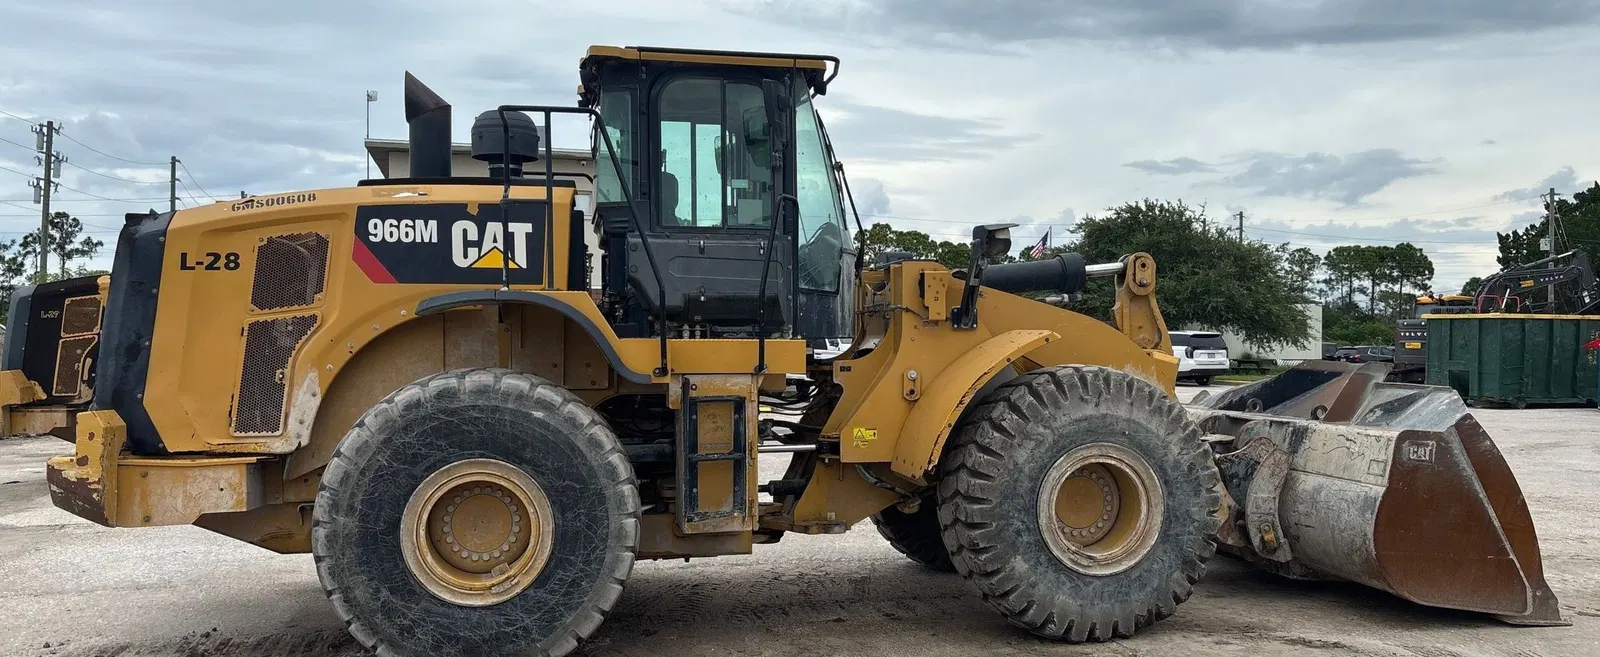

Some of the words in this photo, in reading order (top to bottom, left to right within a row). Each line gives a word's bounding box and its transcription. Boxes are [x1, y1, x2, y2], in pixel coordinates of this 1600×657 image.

[367, 218, 438, 243] 966M
[451, 219, 533, 269] CAT
[180, 252, 241, 271] L-28
[1409, 445, 1432, 460] CAT
